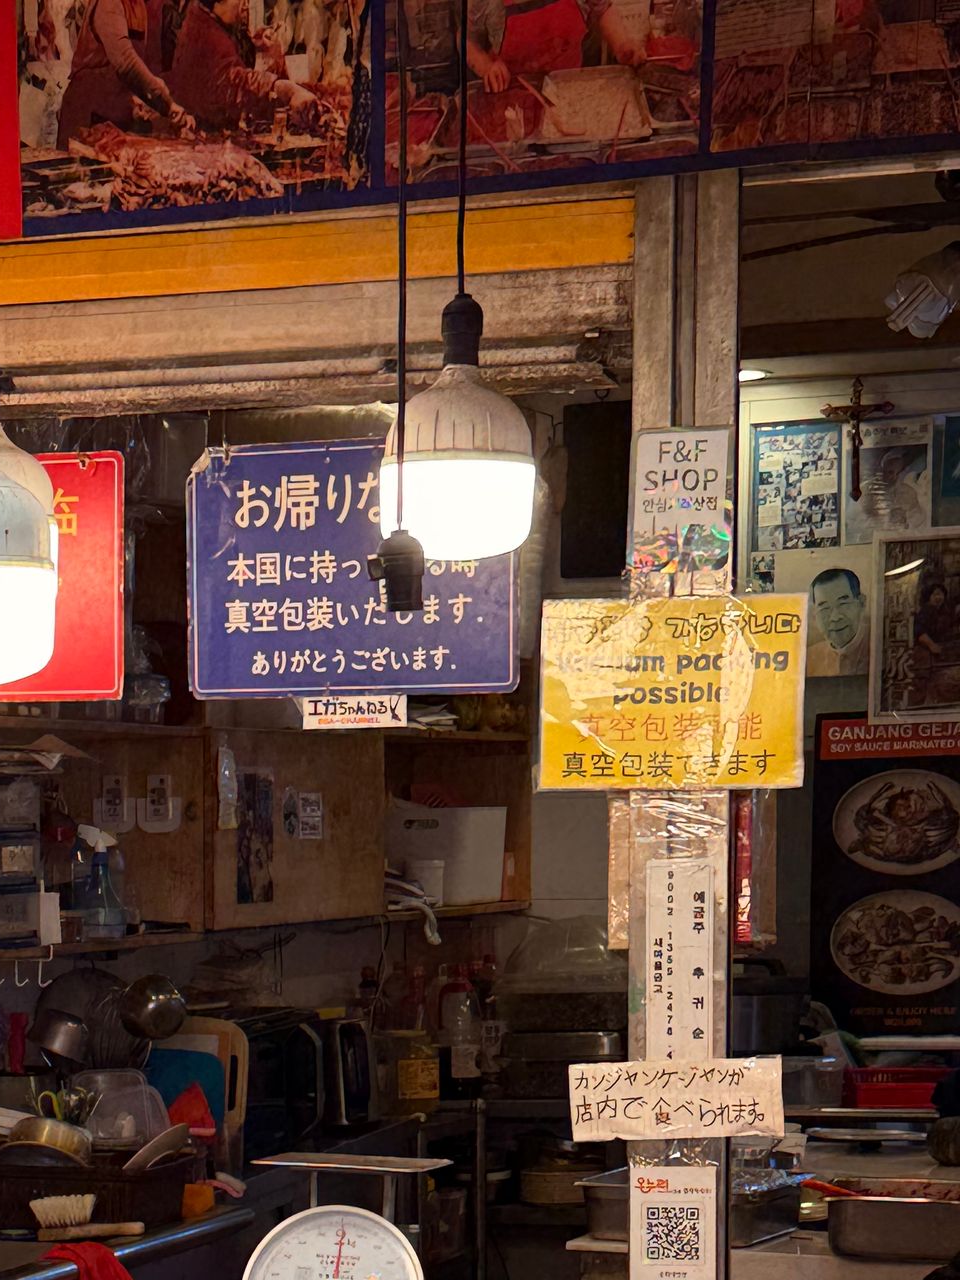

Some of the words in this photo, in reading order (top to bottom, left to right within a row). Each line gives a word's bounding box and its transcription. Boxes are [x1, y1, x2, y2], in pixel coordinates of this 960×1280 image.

[658, 439, 709, 463] F&F
[643, 468, 719, 492] SHOP
[828, 724, 912, 740] GANJANG
[831, 743, 851, 753] SOY
[855, 741, 891, 751] SAUCE
